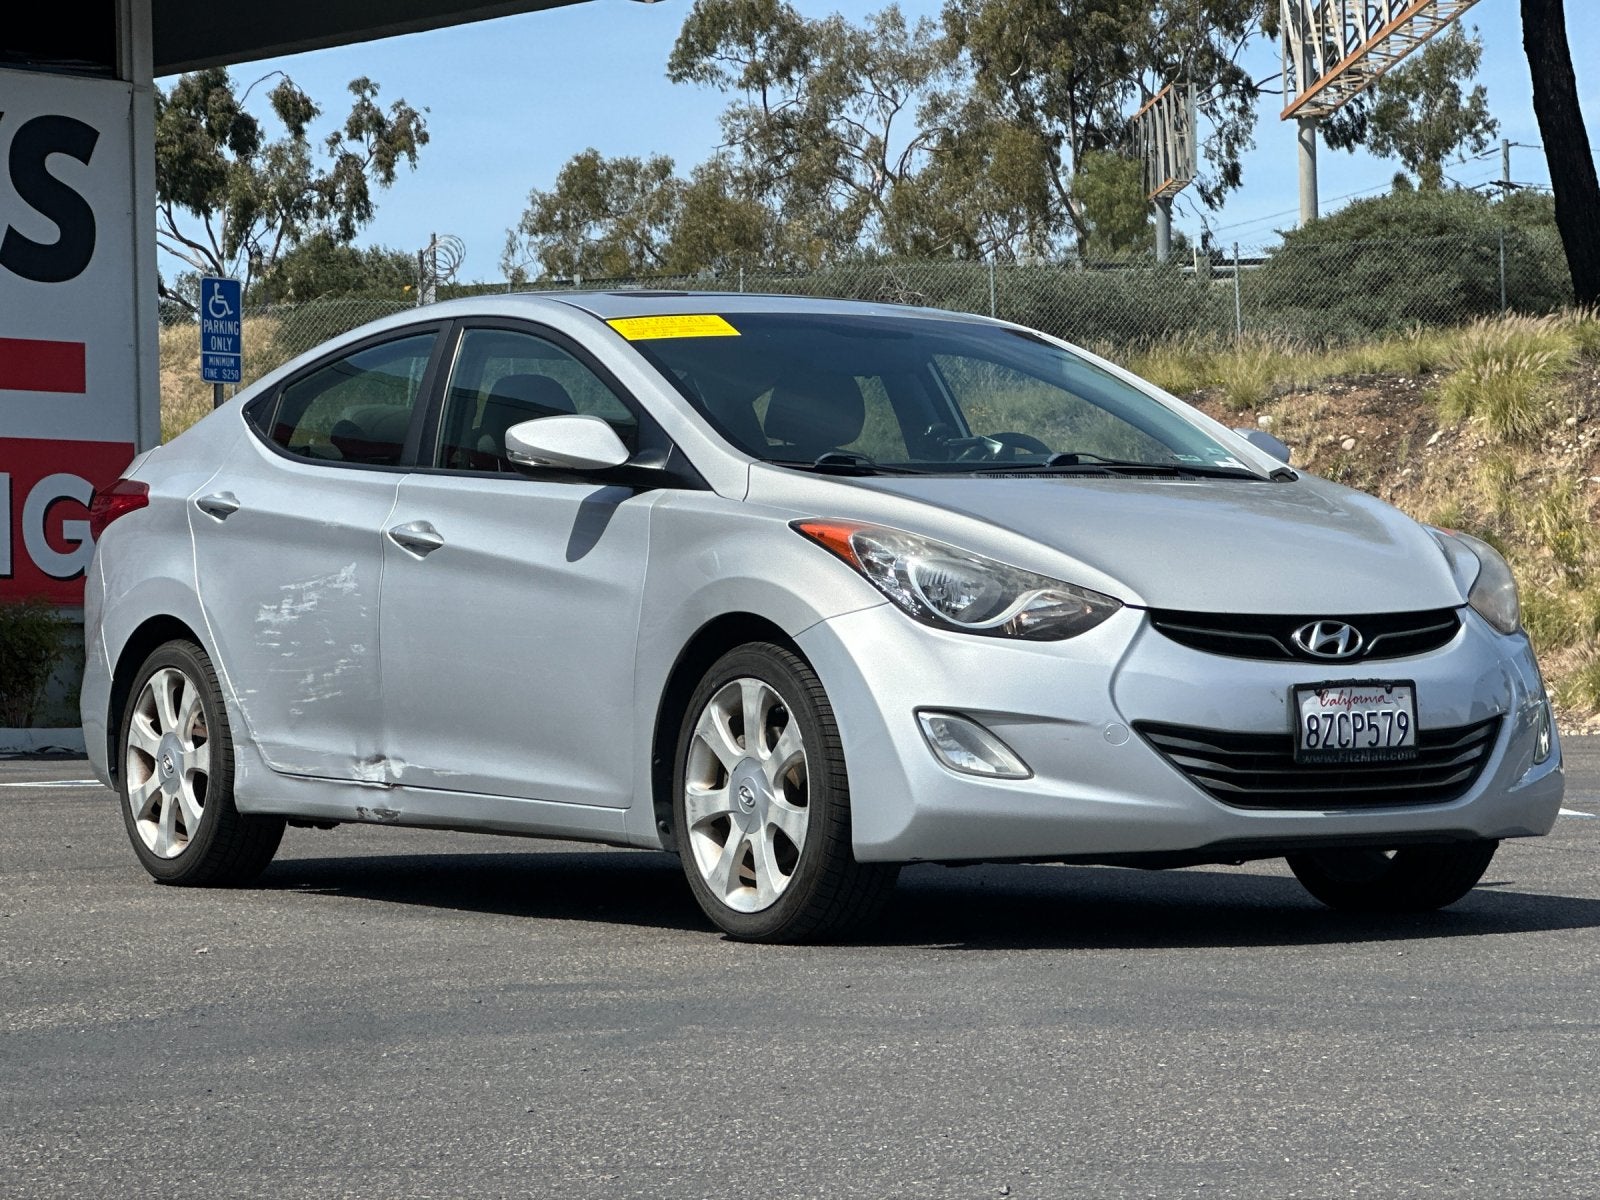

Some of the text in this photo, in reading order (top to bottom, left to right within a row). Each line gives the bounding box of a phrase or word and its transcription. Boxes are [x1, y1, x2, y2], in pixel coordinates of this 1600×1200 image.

[0, 111, 100, 283] S
[203, 319, 239, 336] PARKING
[210, 335, 232, 351] ONLY
[208, 356, 235, 368] MINIMUM
[204, 367, 239, 380] FINE $250
[1320, 688, 1393, 711] California
[1305, 710, 1410, 749] 8ZCP579
